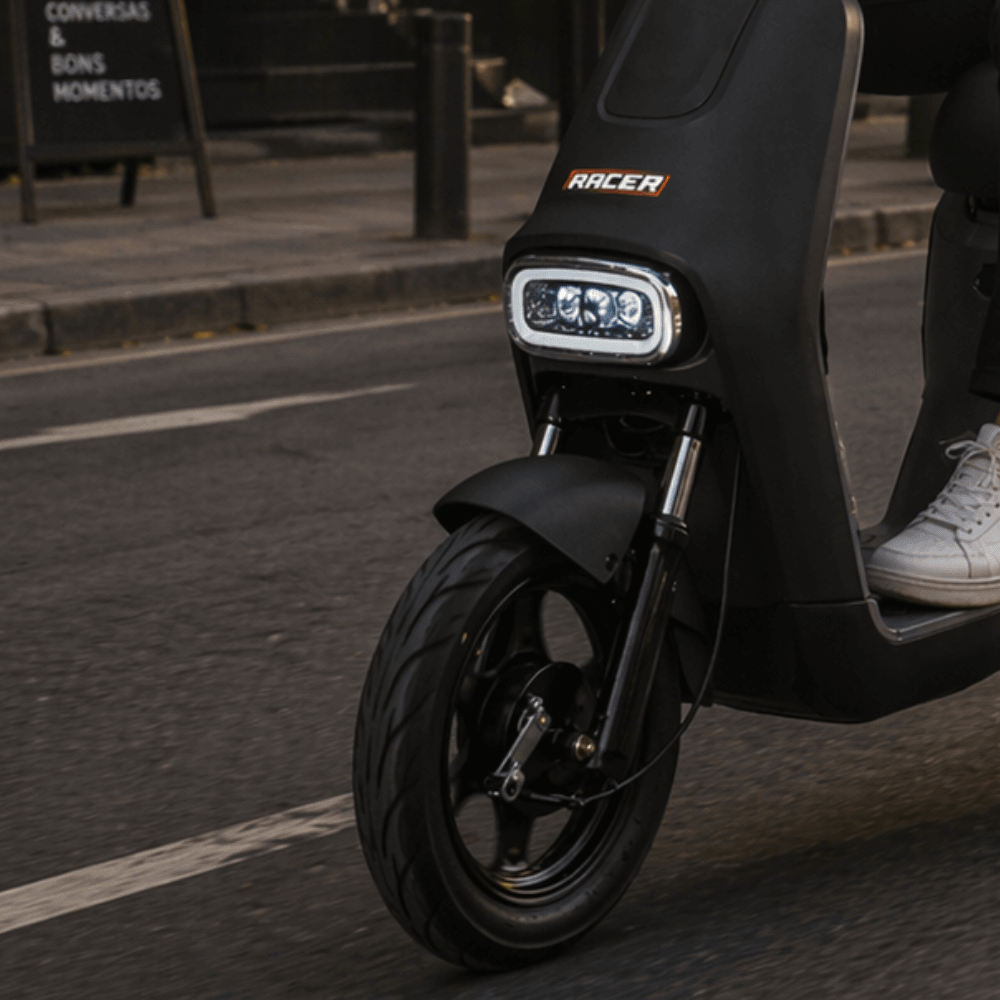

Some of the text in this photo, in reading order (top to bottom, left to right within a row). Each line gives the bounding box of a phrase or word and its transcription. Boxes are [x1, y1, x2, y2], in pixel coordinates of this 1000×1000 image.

[45, 1, 151, 22] CONVERSAS
[49, 25, 66, 47] &
[51, 52, 106, 76] BONS
[53, 78, 162, 102] MOMENTOS
[567, 173, 664, 192] RACER
